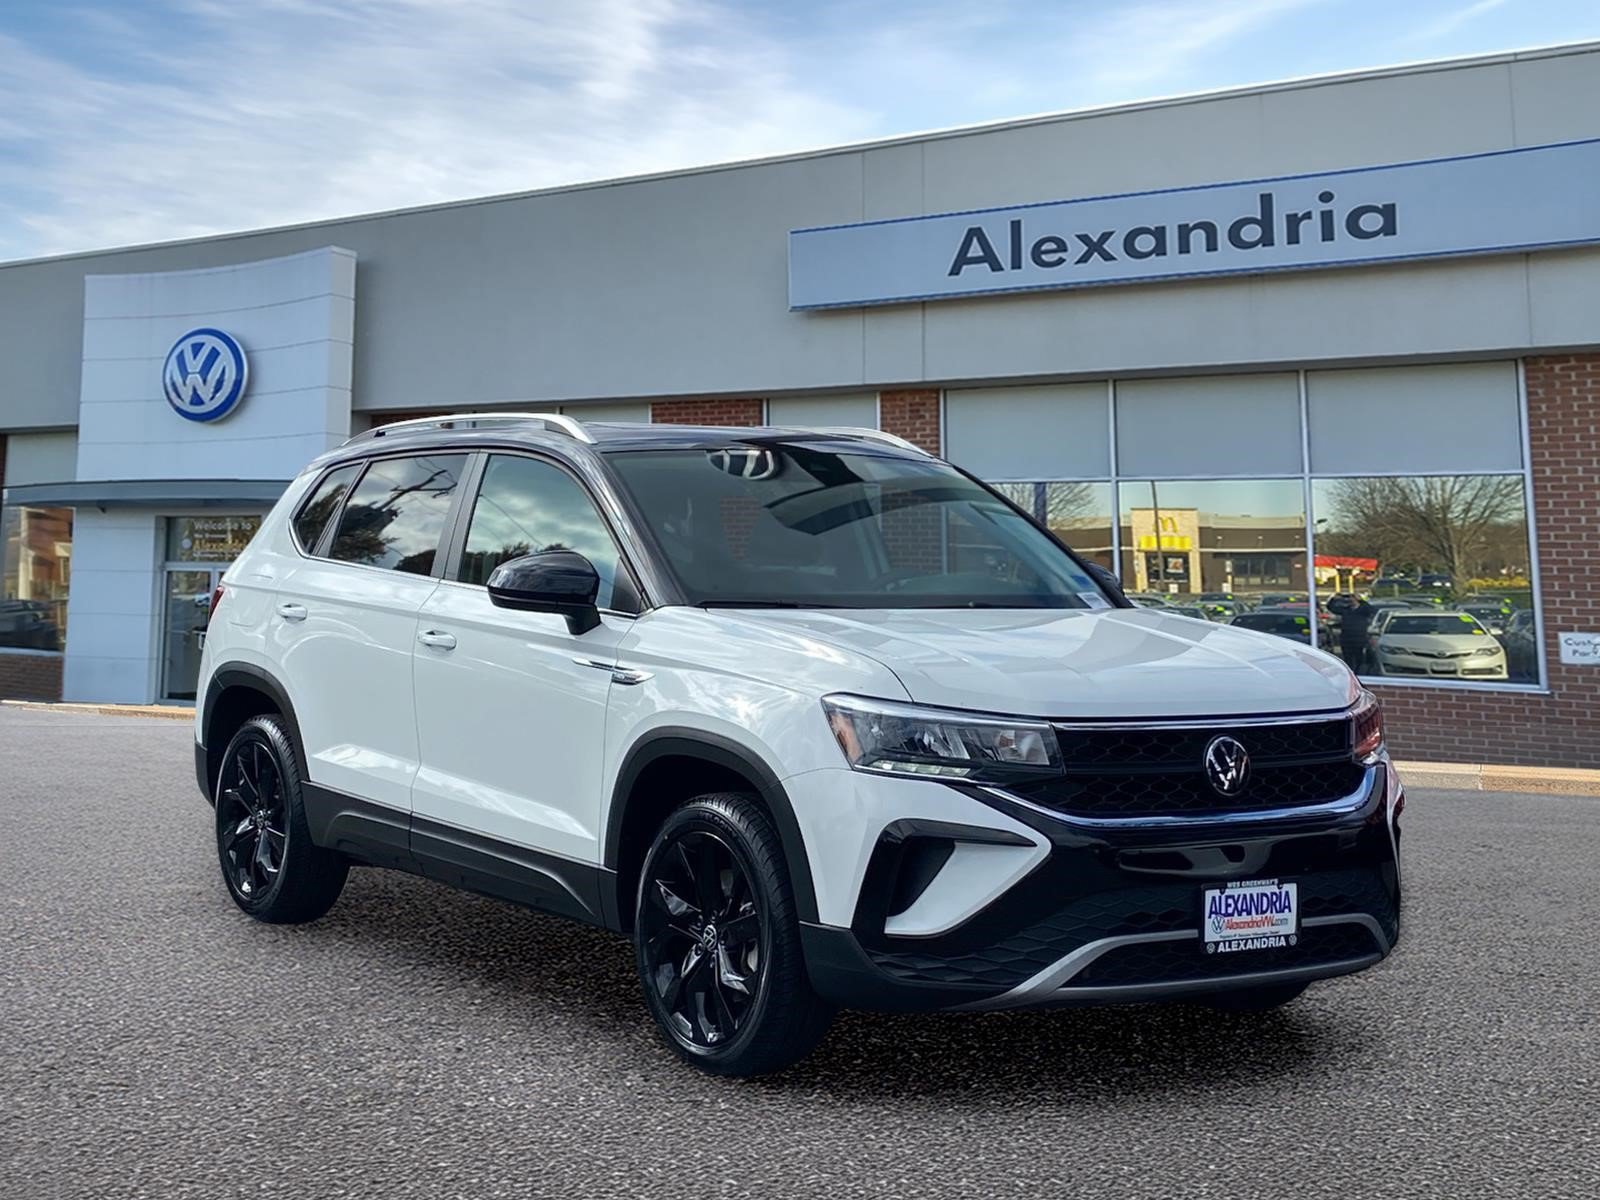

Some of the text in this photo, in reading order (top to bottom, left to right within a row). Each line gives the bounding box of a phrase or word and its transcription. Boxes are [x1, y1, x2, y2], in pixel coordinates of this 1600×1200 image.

[946, 188, 1398, 277] Alexandria
[165, 333, 237, 414] VW
[193, 518, 239, 531] Welcome
[1206, 737, 1249, 796] VW
[1208, 890, 1292, 919] ALEXANDRIA
[1217, 936, 1286, 952] ALEXANDRIA
